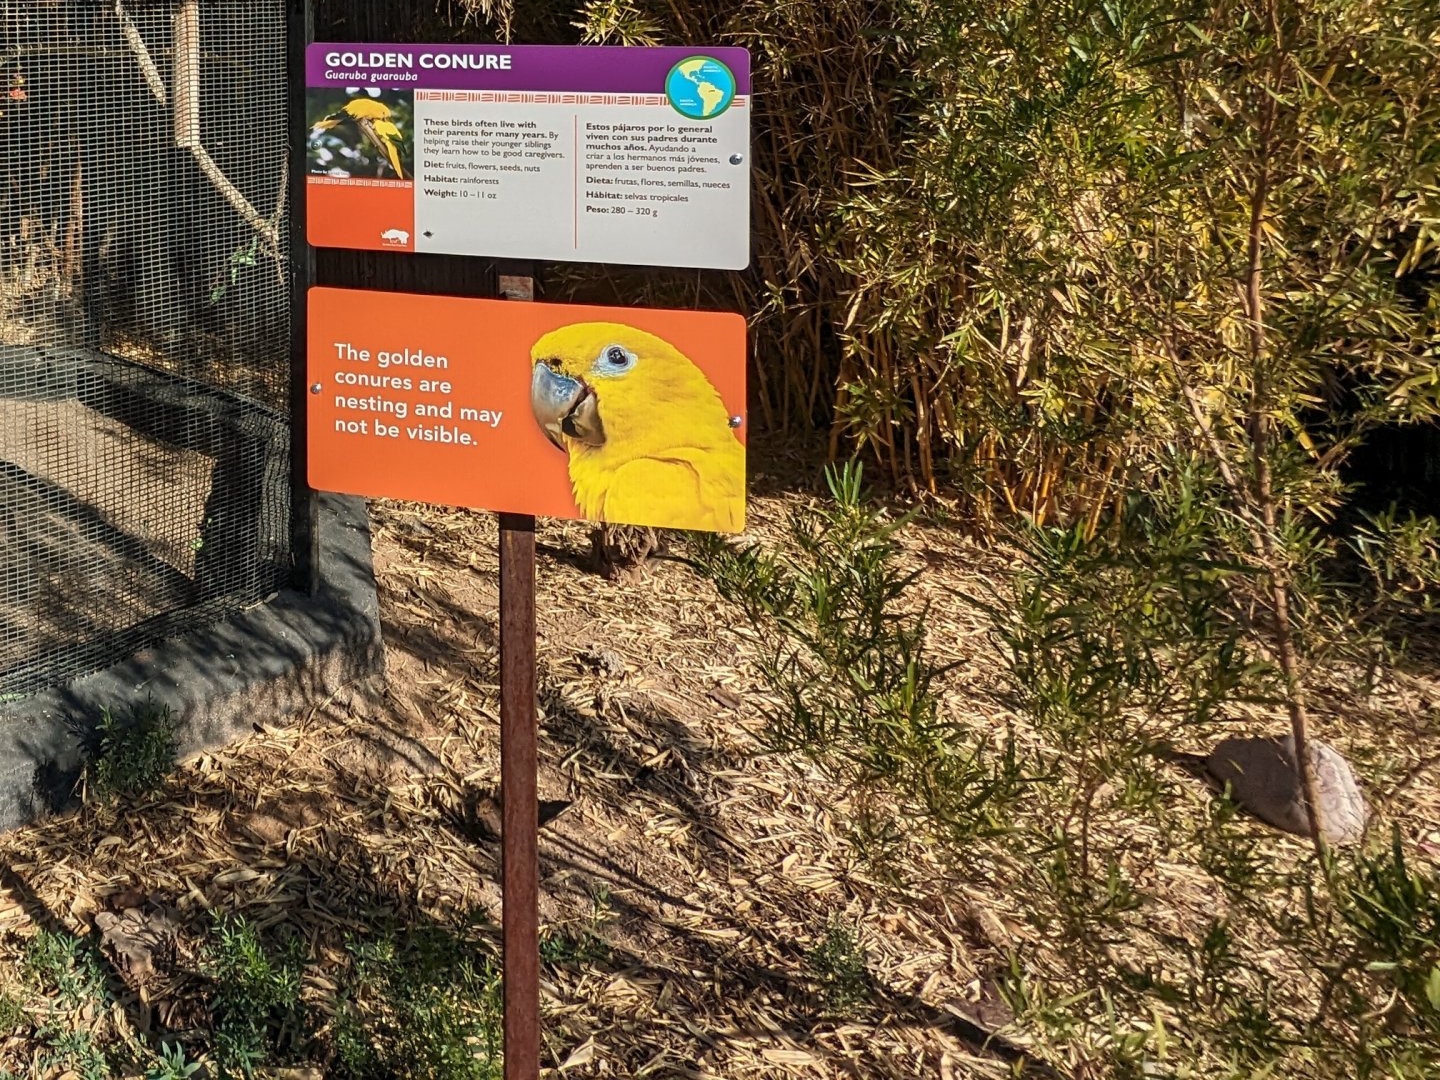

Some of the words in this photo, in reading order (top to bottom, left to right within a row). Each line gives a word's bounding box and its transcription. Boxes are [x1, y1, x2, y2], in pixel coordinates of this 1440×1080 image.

[325, 52, 413, 68] GOLDEN
[419, 54, 512, 69] CONURE
[325, 70, 367, 80] Guaruba
[370, 72, 418, 82] guarouba
[475, 120, 498, 128] often
[613, 123, 645, 132] pájaros
[678, 125, 712, 134] general
[549, 132, 558, 140] By
[648, 135, 678, 143] padres
[681, 135, 717, 143] durante
[424, 138, 449, 146] helping
[524, 141, 551, 150] siblings
[503, 150, 522, 158] good
[524, 152, 565, 160] caregivers.
[649, 146, 689, 154] Ayudando
[627, 154, 666, 162] hermanos
[687, 156, 720, 164] jóvenes,
[446, 162, 467, 170] fruits,
[468, 162, 498, 171] flowers,
[500, 164, 523, 172] seeds,
[586, 163, 622, 171] aprenden
[647, 164, 675, 172] buenos
[678, 165, 706, 173] padres.
[424, 175, 458, 183] Habitat:
[615, 177, 639, 186] frutas,
[641, 178, 666, 187] flores,
[668, 180, 701, 188] semillas,
[424, 189, 457, 198] Weight:
[460, 190, 468, 198] 10
[586, 191, 622, 200] Hábitat:
[624, 193, 647, 201] selvas
[650, 194, 688, 202] tropicales
[586, 206, 609, 214] Peso:
[334, 343, 370, 361] The
[378, 348, 448, 368] golden
[335, 372, 412, 390] conures
[419, 380, 451, 393] are
[335, 395, 408, 418] nesting
[415, 402, 452, 418] and
[460, 407, 503, 427] may
[335, 420, 368, 434] not
[375, 419, 400, 437] be
[407, 424, 478, 445] visible.
